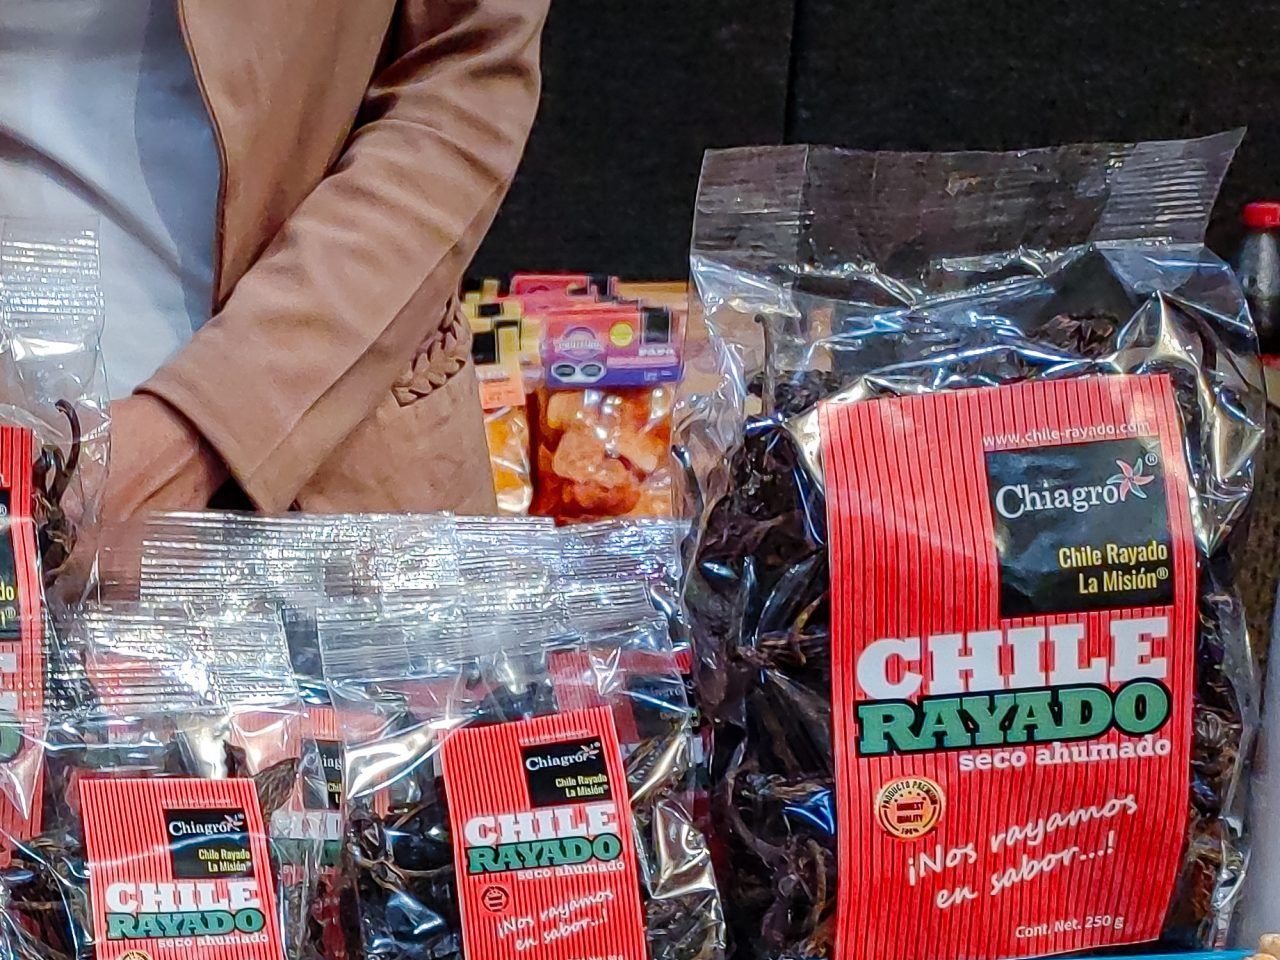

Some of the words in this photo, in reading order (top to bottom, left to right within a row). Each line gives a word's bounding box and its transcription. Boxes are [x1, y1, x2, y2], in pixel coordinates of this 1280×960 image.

[995, 479, 1119, 520] Chiagro
[1058, 546, 1103, 569] Chile
[1106, 540, 1168, 566] Rayado
[1078, 573, 1099, 595] La
[856, 616, 1169, 701] CHILE
[855, 678, 1173, 757] RAYADO
[959, 749, 1028, 772] seco
[1034, 735, 1172, 766] ahumado
[565, 787, 577, 798] La
[576, 773, 608, 786] Rayado
[168, 820, 227, 837] Chiagro
[464, 803, 618, 847] CHILE
[990, 793, 1139, 855] rayamos
[207, 861, 219, 873] La
[220, 848, 251, 861] Rayado
[466, 832, 624, 876] RAYADO
[517, 867, 552, 881] seco
[554, 859, 627, 877] ahumado
[105, 881, 258, 912] CHILE
[538, 888, 615, 922] rayamos
[935, 885, 979, 910] en
[106, 908, 266, 940] RAYADO
[1084, 915, 1111, 929] 250
[157, 938, 193, 949] seco
[196, 932, 270, 947] ahumado
[514, 936, 538, 952] en
